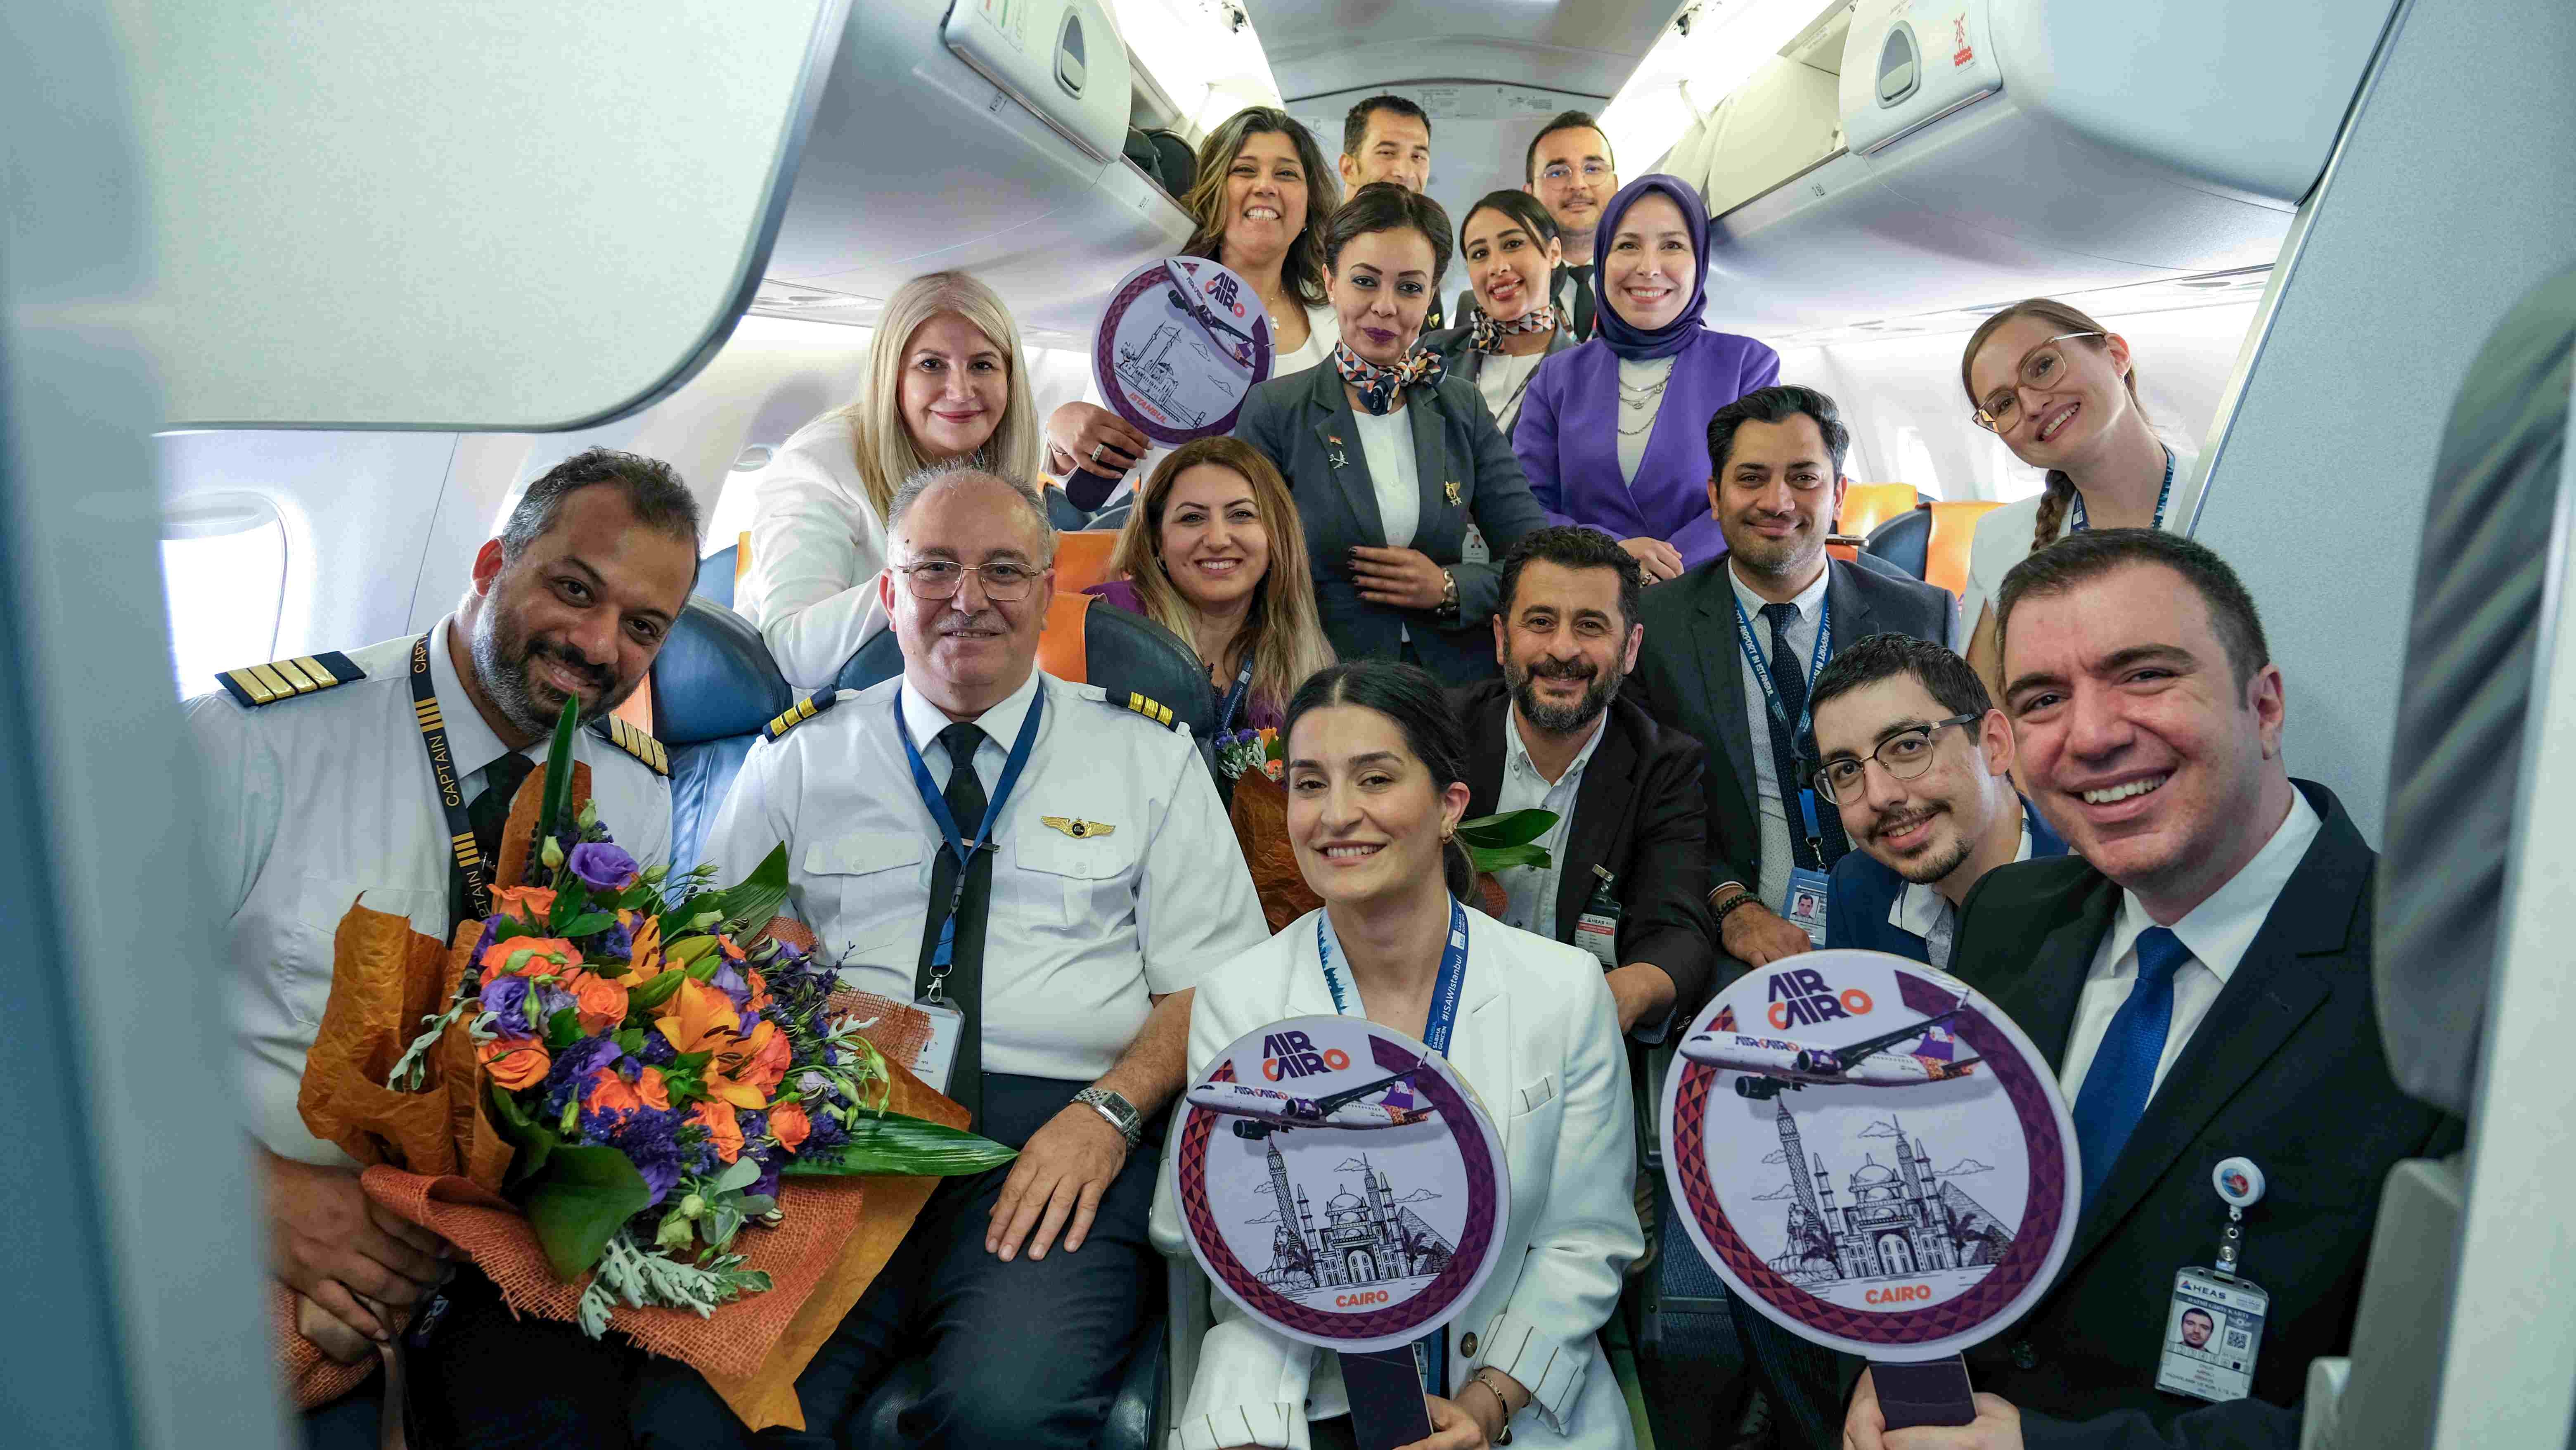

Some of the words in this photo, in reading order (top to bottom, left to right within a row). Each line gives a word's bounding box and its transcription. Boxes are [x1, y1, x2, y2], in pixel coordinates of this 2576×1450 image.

[1205, 280, 1245, 318] CAIRO
[1212, 272, 1238, 299] AIR
[1129, 392, 1167, 424] ISTANBUL
[1739, 625, 1757, 654] AIRPORT
[1755, 663, 1774, 697] ISTANBUL
[1817, 628, 1830, 661] AIRPORT
[429, 735, 460, 807] CAPTAIN
[466, 870, 490, 918] PTAIN
[1441, 954, 1463, 1021] #ISAWIstanbul
[1769, 968, 1834, 1003] AIR
[1767, 988, 1873, 1031] CAIRO
[1263, 1031, 1319, 1059] AIR
[1428, 1021, 1437, 1046] STANBUL
[1432, 1027, 1442, 1049] SABIHA
[1262, 1048, 1350, 1082] CAIRO
[1335, 1290, 1389, 1308] CAIRO
[1865, 1284, 1931, 1305] CAIRO
[2193, 1284, 2226, 1299] HEAS
